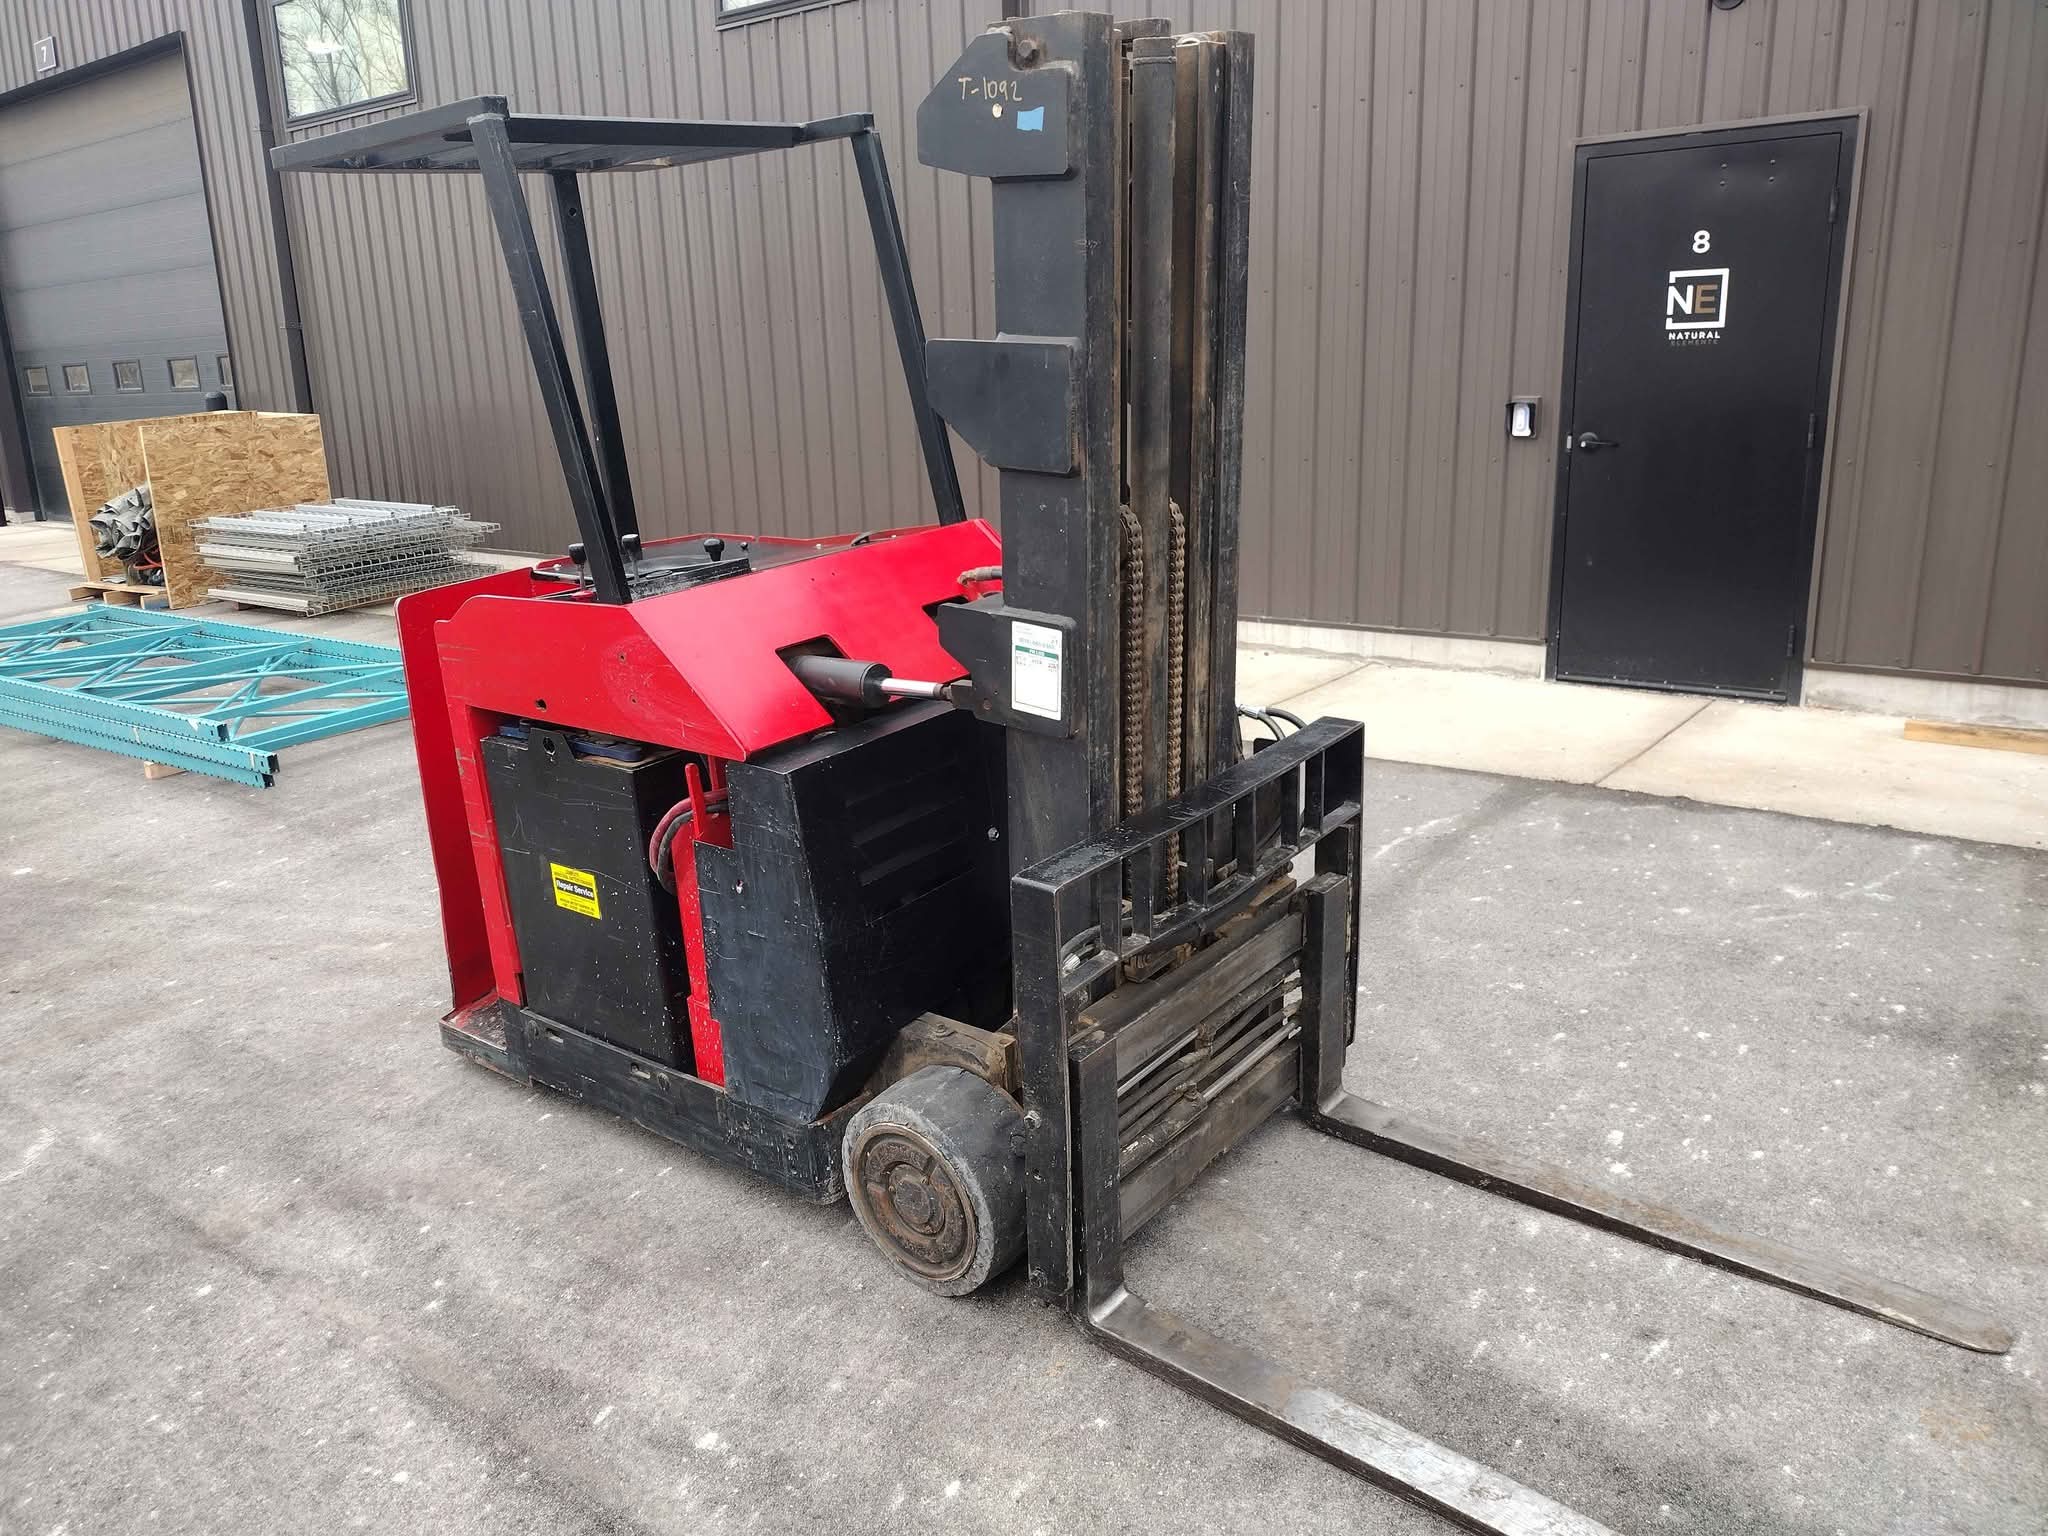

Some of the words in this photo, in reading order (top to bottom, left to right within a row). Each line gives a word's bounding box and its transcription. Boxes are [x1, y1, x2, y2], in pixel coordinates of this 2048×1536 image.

[958, 76, 1023, 102] T-1092
[1692, 229, 1711, 254] 8
[1666, 284, 1718, 316] NE
[1668, 330, 1721, 341] NATURAL
[573, 884, 595, 899] Service
